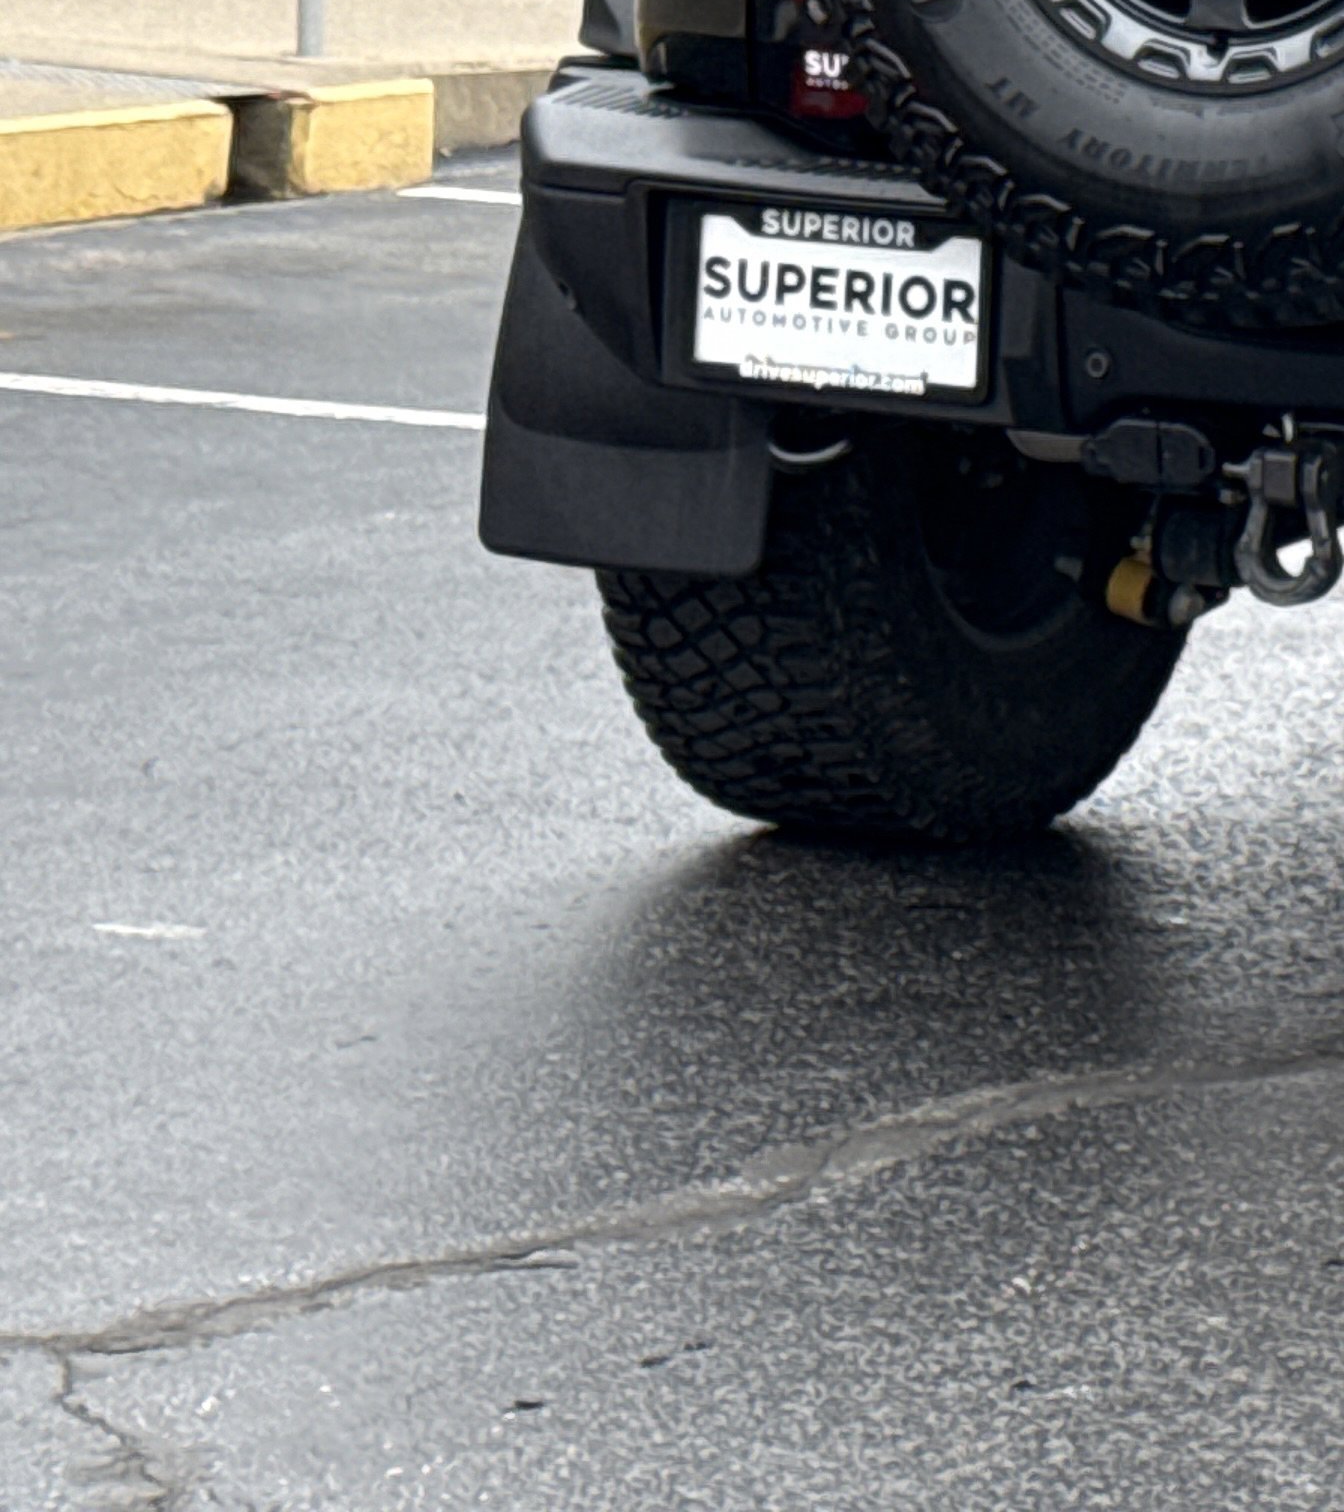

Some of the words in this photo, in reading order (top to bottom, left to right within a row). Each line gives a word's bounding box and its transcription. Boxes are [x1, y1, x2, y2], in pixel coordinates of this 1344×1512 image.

[760, 207, 916, 249] SUPERIOR
[702, 254, 977, 325] SUPERIOR
[702, 305, 869, 338] AUTOMOTIVE
[884, 321, 977, 346] GROUP
[738, 356, 927, 396] drivesuperior.com
